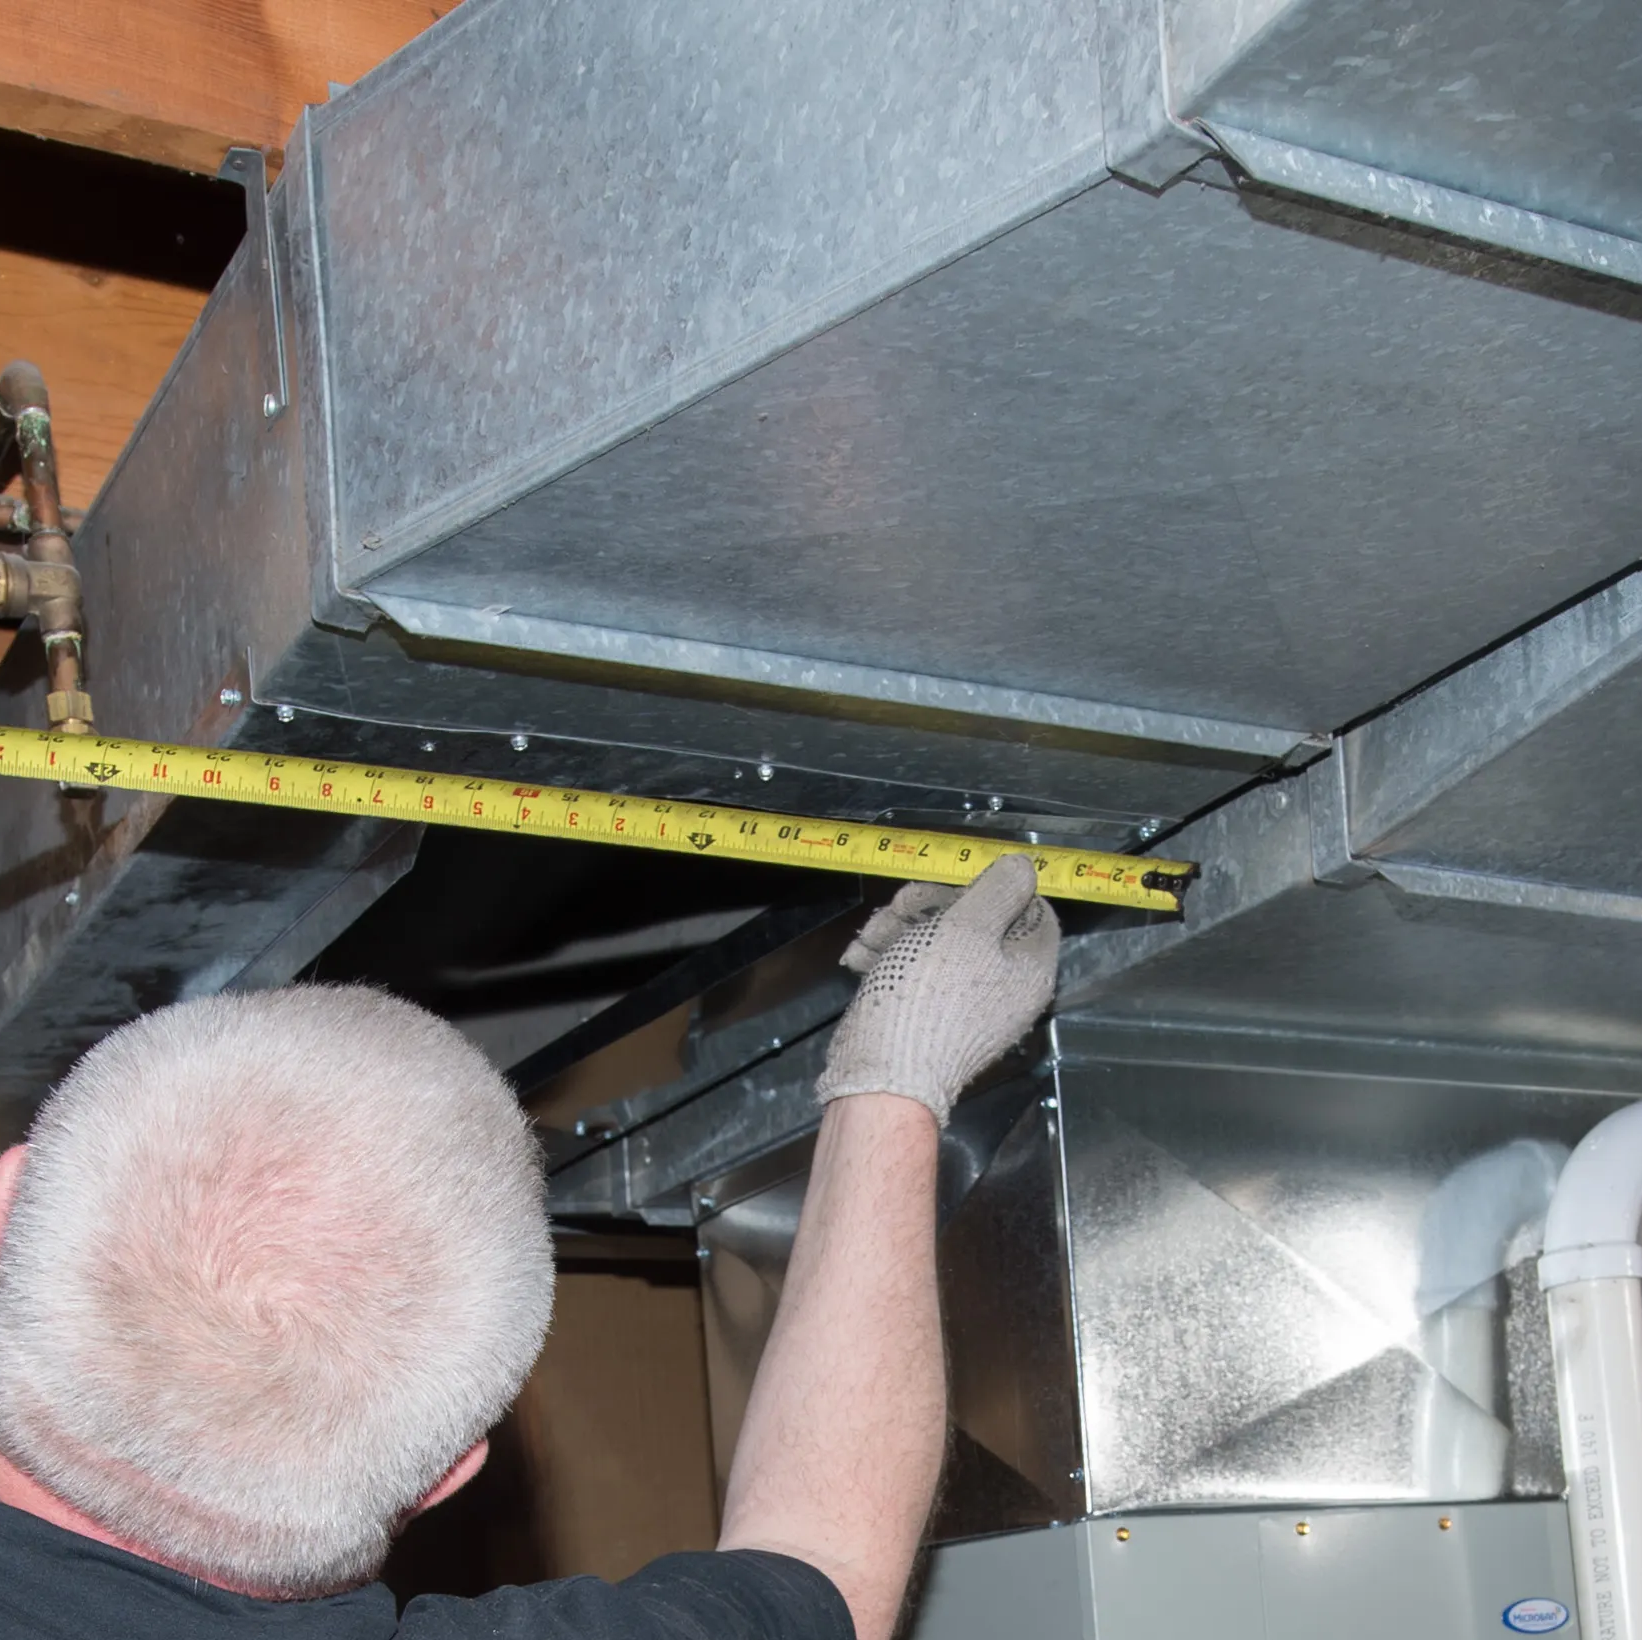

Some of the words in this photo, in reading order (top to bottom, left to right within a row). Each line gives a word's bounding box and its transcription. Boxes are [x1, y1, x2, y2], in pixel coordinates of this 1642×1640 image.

[151, 746, 177, 756] 23
[206, 752, 232, 762] 22
[265, 757, 287, 768] 21
[313, 764, 339, 774] 20
[153, 763, 168, 778] 11
[203, 769, 222, 784] 10
[365, 770, 385, 779] 19
[269, 777, 280, 791] 9
[415, 776, 435, 785] 18
[464, 780, 484, 790] 17
[321, 783, 333, 797] 8
[372, 789, 383, 803] 7
[423, 796, 434, 809] 6
[561, 793, 580, 802] 15
[609, 799, 627, 808] 14
[473, 801, 483, 815] 5
[521, 807, 531, 820] 4
[654, 804, 673, 813] 13
[698, 810, 716, 819] 12
[569, 812, 579, 826] 3
[615, 818, 626, 831] 2
[739, 821, 759, 836] 11
[778, 826, 802, 841] 10
[837, 833, 849, 846] 9
[878, 838, 891, 851] 8
[918, 843, 930, 857] 7
[959, 849, 971, 862] 6
[1034, 859, 1048, 872] 4
[1075, 863, 1087, 877] 3
[1112, 868, 1124, 882] 2
[1579, 1431, 1598, 1458] 140
[1581, 1465, 1605, 1520] EXCEED
[1588, 1528, 1607, 1547] TO
[1591, 1555, 1611, 1583] NOT
